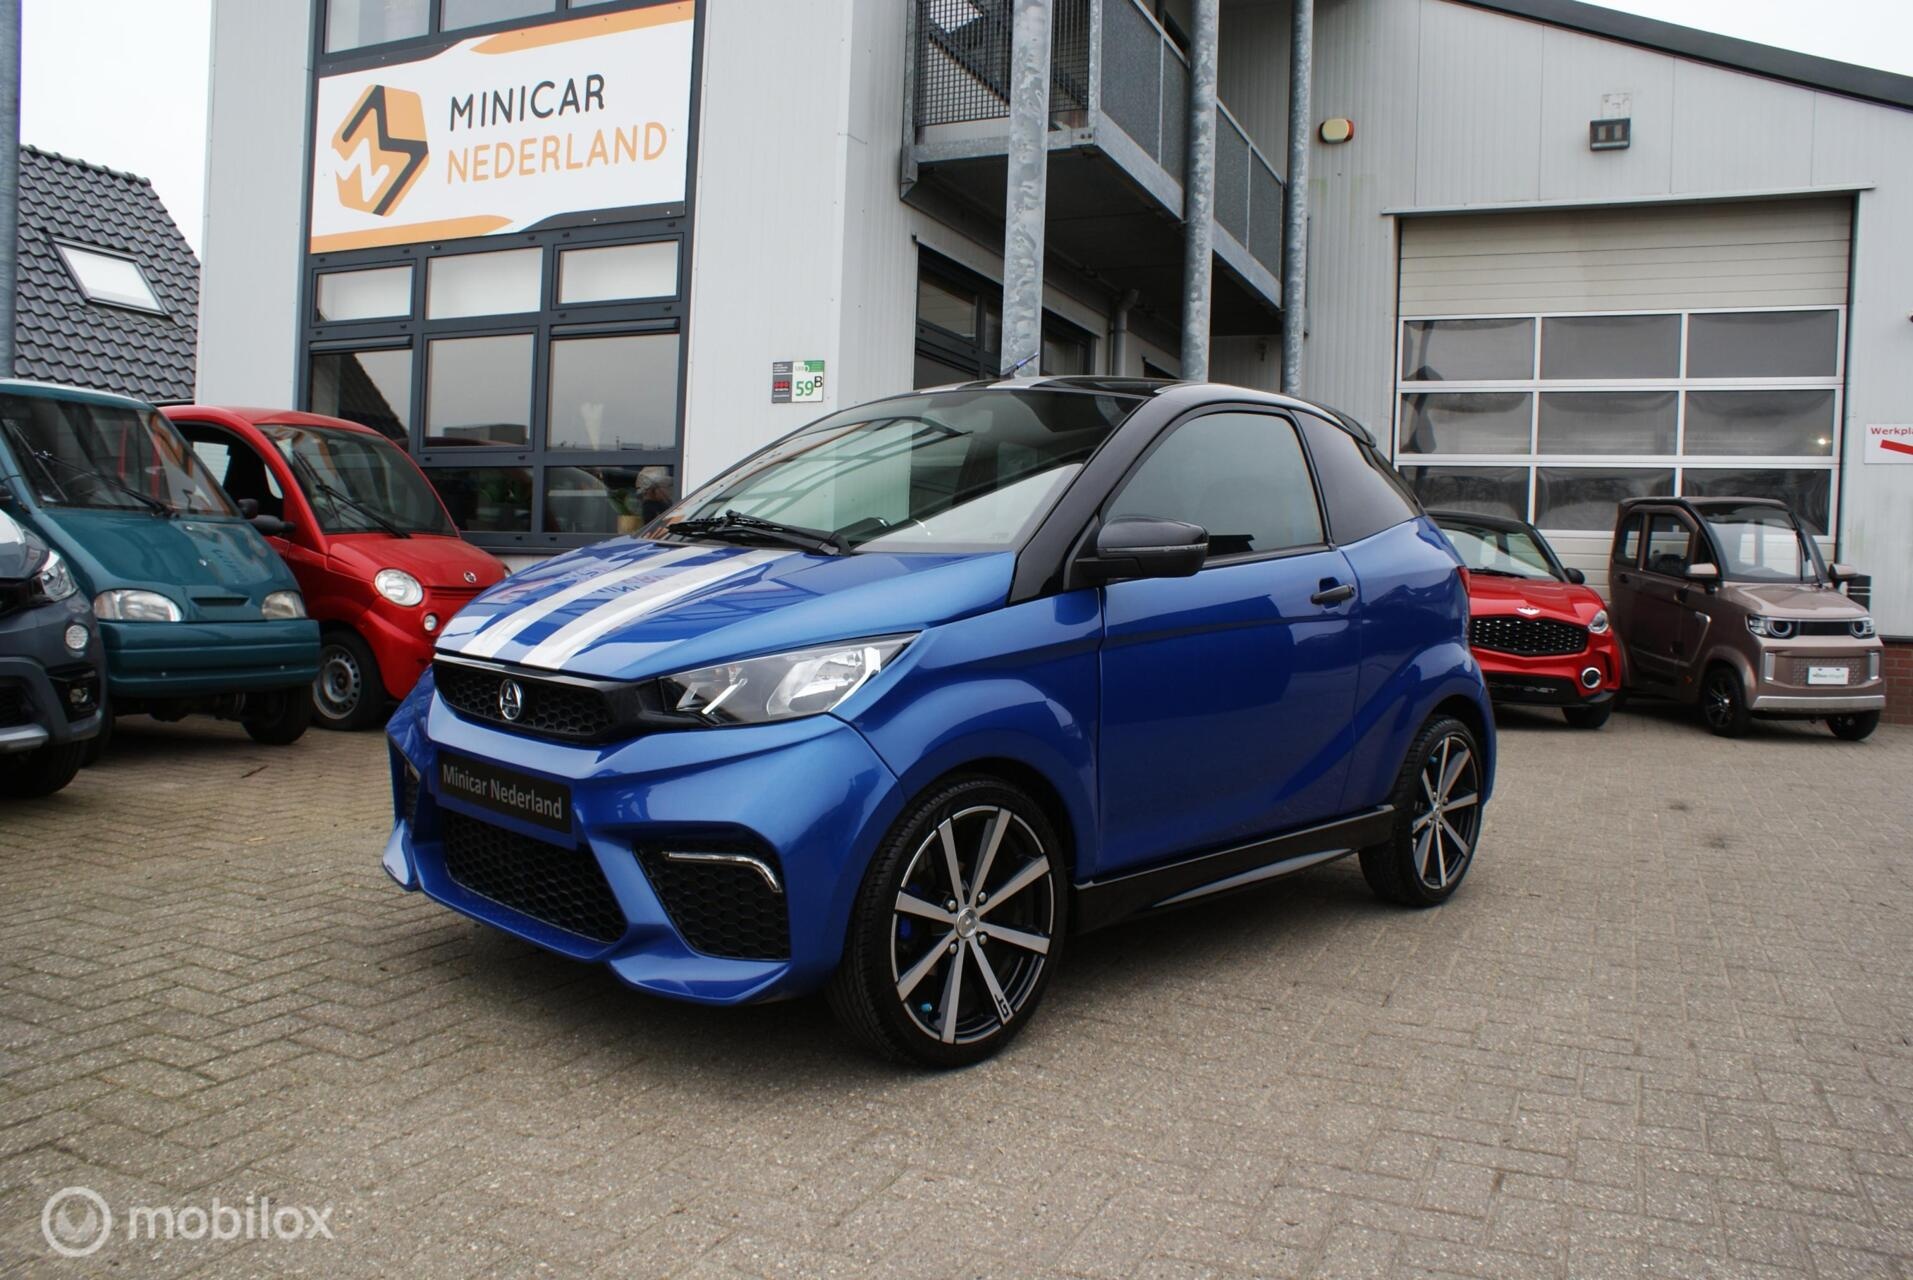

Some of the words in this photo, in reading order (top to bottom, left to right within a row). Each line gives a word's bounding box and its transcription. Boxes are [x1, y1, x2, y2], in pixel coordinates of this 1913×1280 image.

[450, 73, 605, 132] MINICAR
[447, 121, 668, 185] NEDERLAND
[443, 763, 487, 796] Minicar
[490, 778, 563, 820] Nederland
